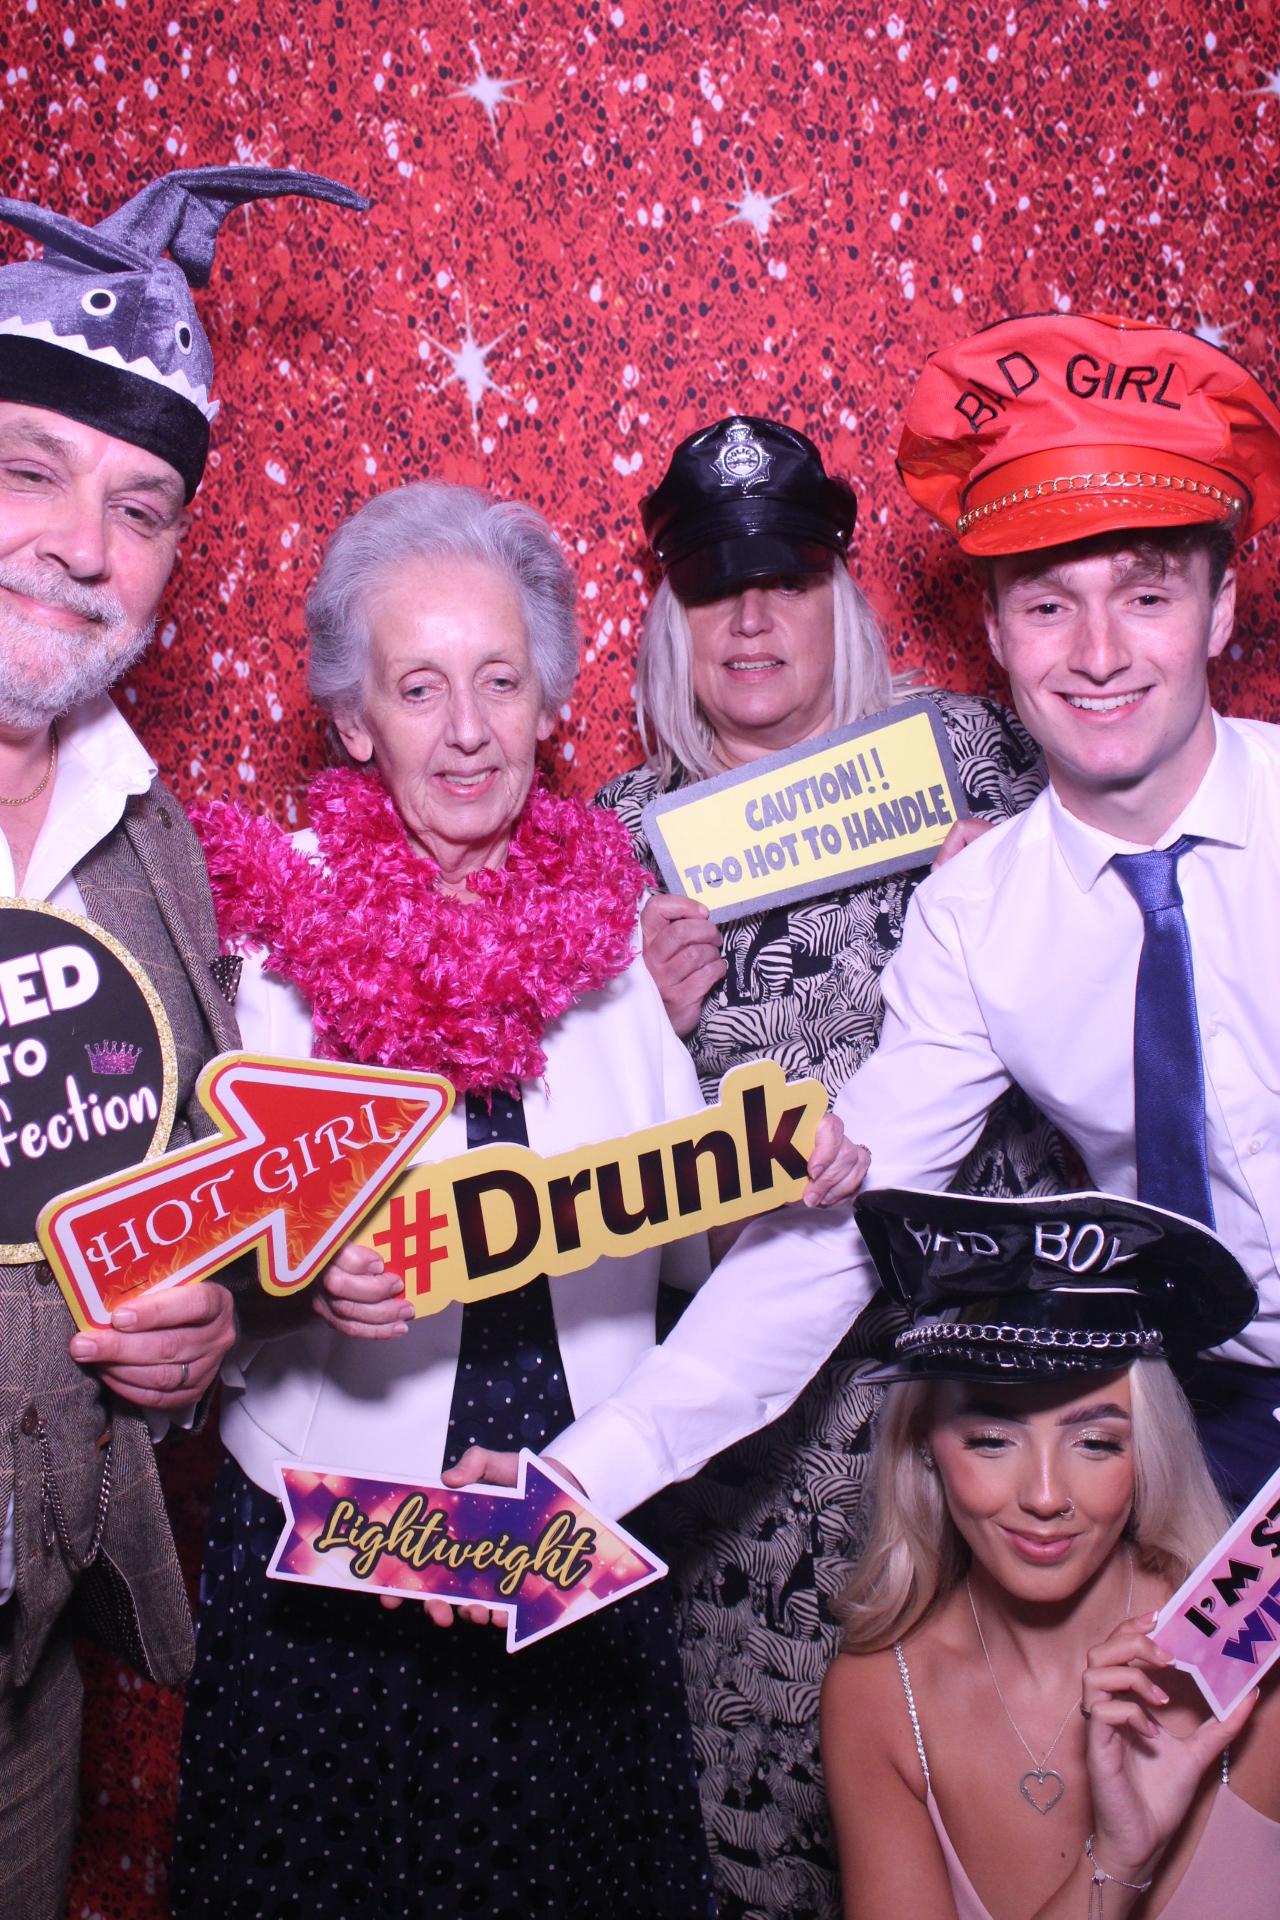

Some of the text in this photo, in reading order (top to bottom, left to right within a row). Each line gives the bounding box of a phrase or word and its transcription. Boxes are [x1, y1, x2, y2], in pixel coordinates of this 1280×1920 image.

[955, 352, 1181, 433] BAD GIRL
[744, 747, 890, 832] CAUTION!!
[684, 784, 953, 895] TOO HOT TO HANDLE
[0, 944, 99, 1028] ED
[86, 1100, 400, 1276] HOT GIRL
[372, 1085, 809, 1299] #Drunk
[1035, 1221, 1138, 1273] BOY
[317, 1493, 596, 1597] Lightweight
[1184, 1558, 1263, 1638] I'M
